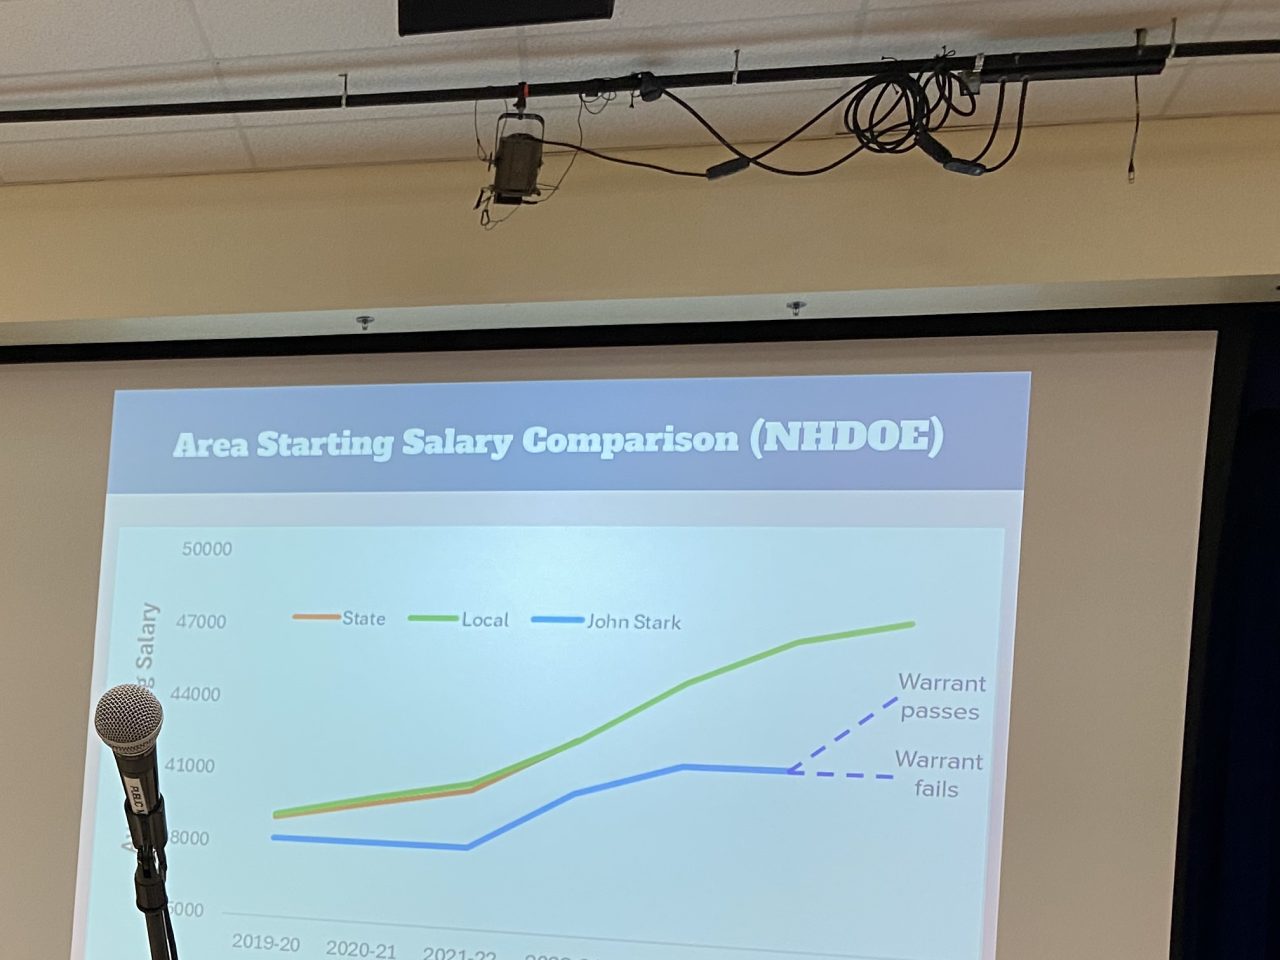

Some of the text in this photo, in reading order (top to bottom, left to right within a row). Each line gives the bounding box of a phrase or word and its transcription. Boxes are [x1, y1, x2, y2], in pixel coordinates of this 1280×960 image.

[172, 415, 944, 462] Area Starting Salary Comparison (NHDOE)
[181, 541, 233, 556] 50000
[176, 613, 227, 629] 47000
[341, 610, 386, 626] State
[462, 611, 509, 628] Local
[587, 613, 681, 630] John Stark
[135, 602, 161, 670] Salary
[899, 672, 987, 692] Warrant
[170, 686, 221, 702] 44000
[901, 704, 980, 722] passes
[164, 757, 215, 773] 41000
[895, 749, 984, 770] Warrant
[915, 779, 959, 798] fails
[169, 830, 210, 846] 8000
[167, 901, 204, 917] 5000
[232, 932, 301, 953] 2019-20
[326, 940, 397, 960] 2020-21
